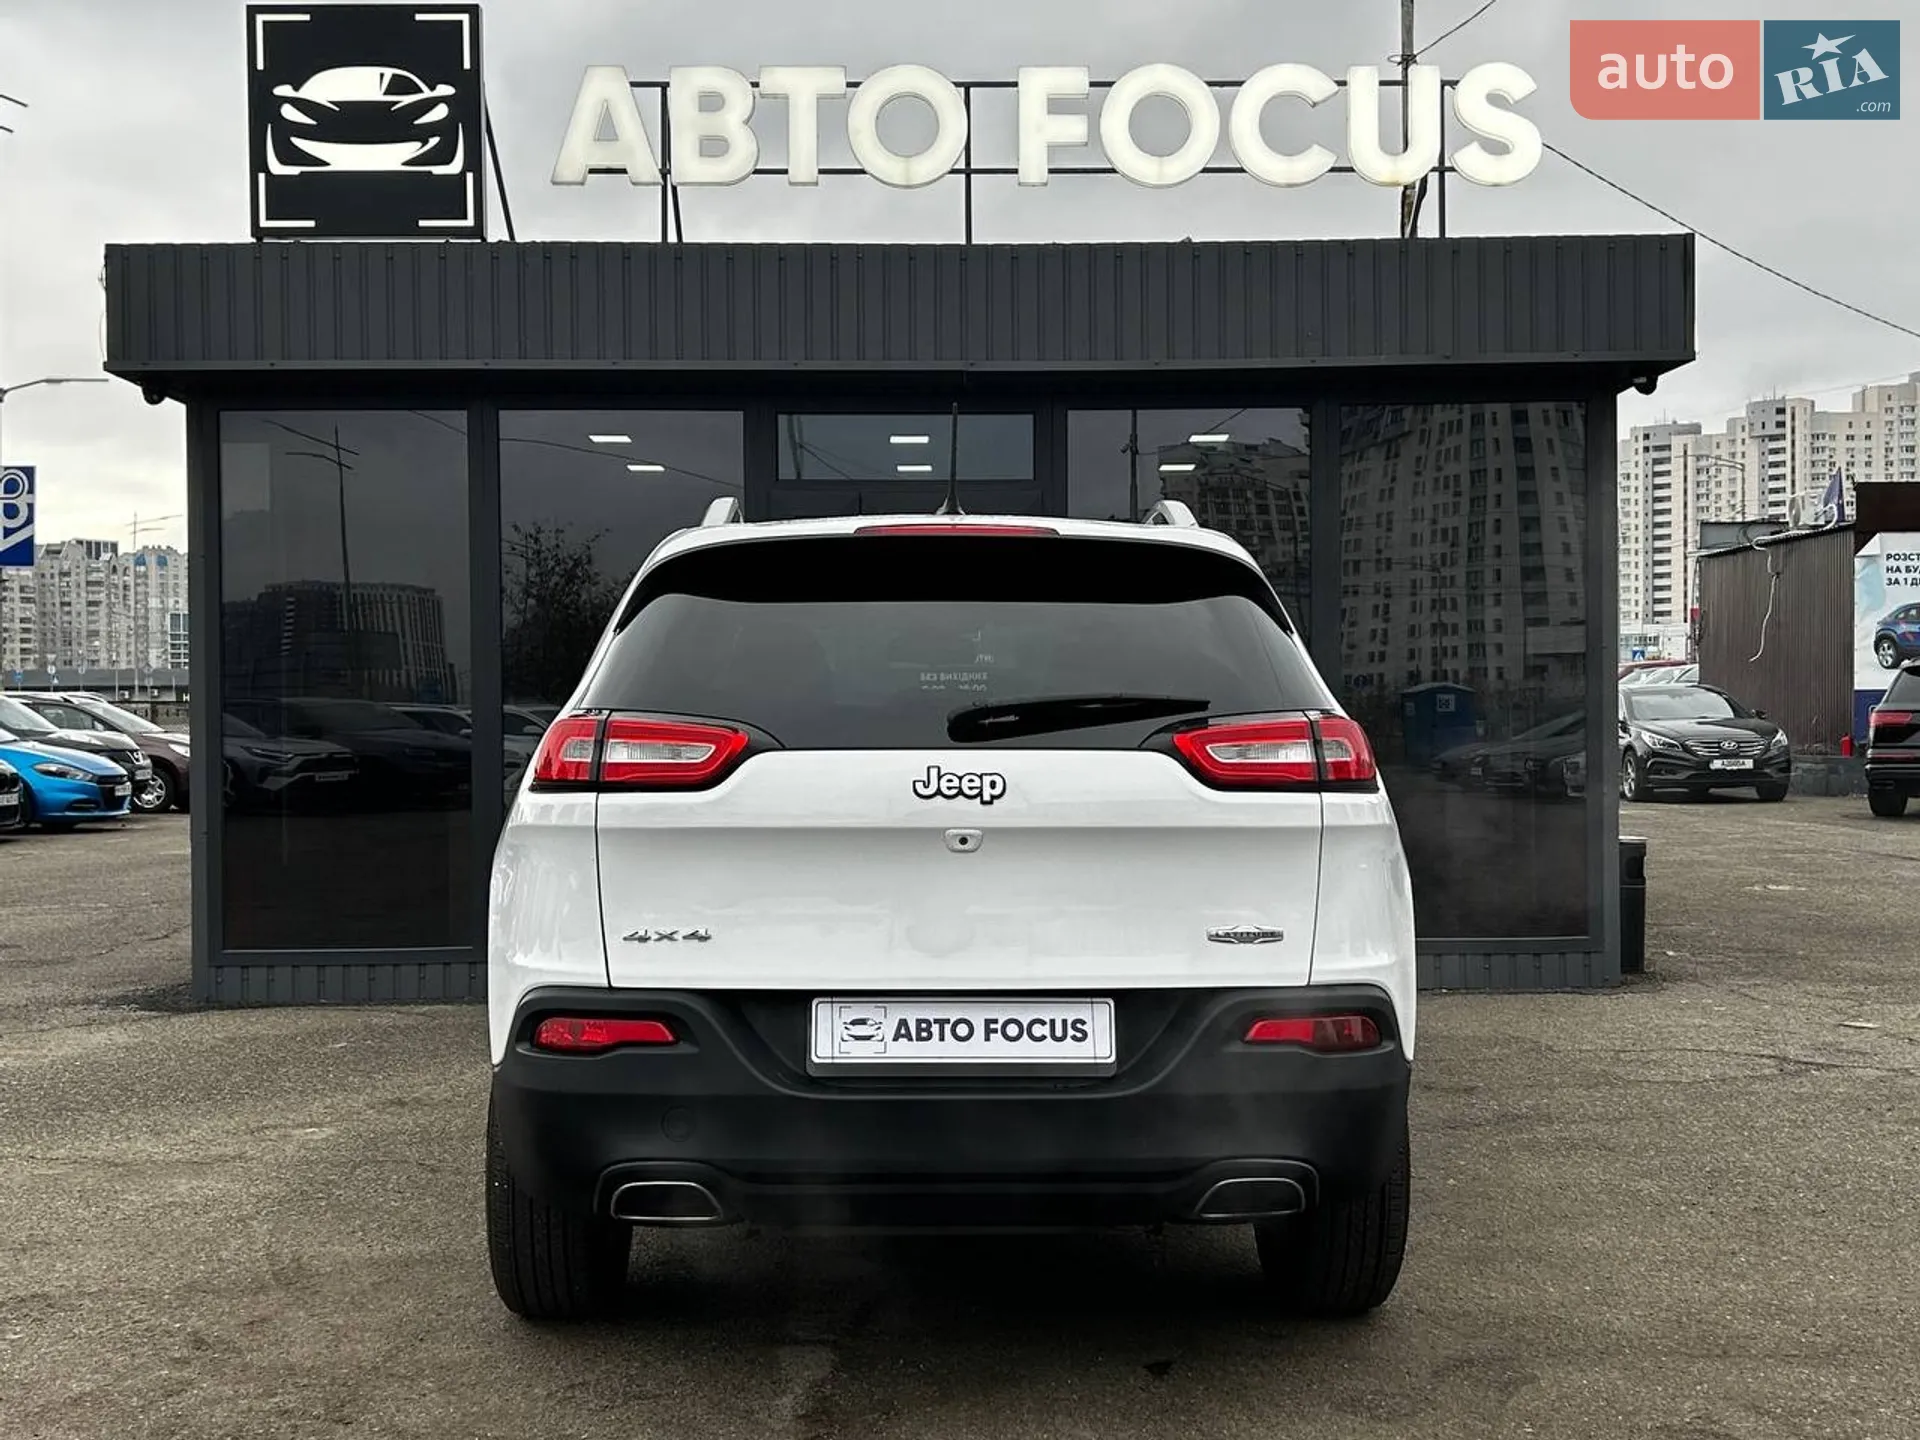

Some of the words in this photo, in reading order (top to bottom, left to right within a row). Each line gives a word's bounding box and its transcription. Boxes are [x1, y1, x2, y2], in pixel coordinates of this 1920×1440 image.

[551, 64, 969, 189] АВТО
[1017, 62, 1543, 189] FOCUS
[1885, 565, 1902, 574] НА
[1905, 565, 1920, 574] БУ
[1885, 577, 1901, 586] ЗА
[1903, 577, 1908, 586] 1
[1910, 577, 1920, 587] Д
[912, 765, 1006, 805] Jeep
[892, 1017, 976, 1043] АВТО
[983, 1017, 1089, 1043] FOCUS
